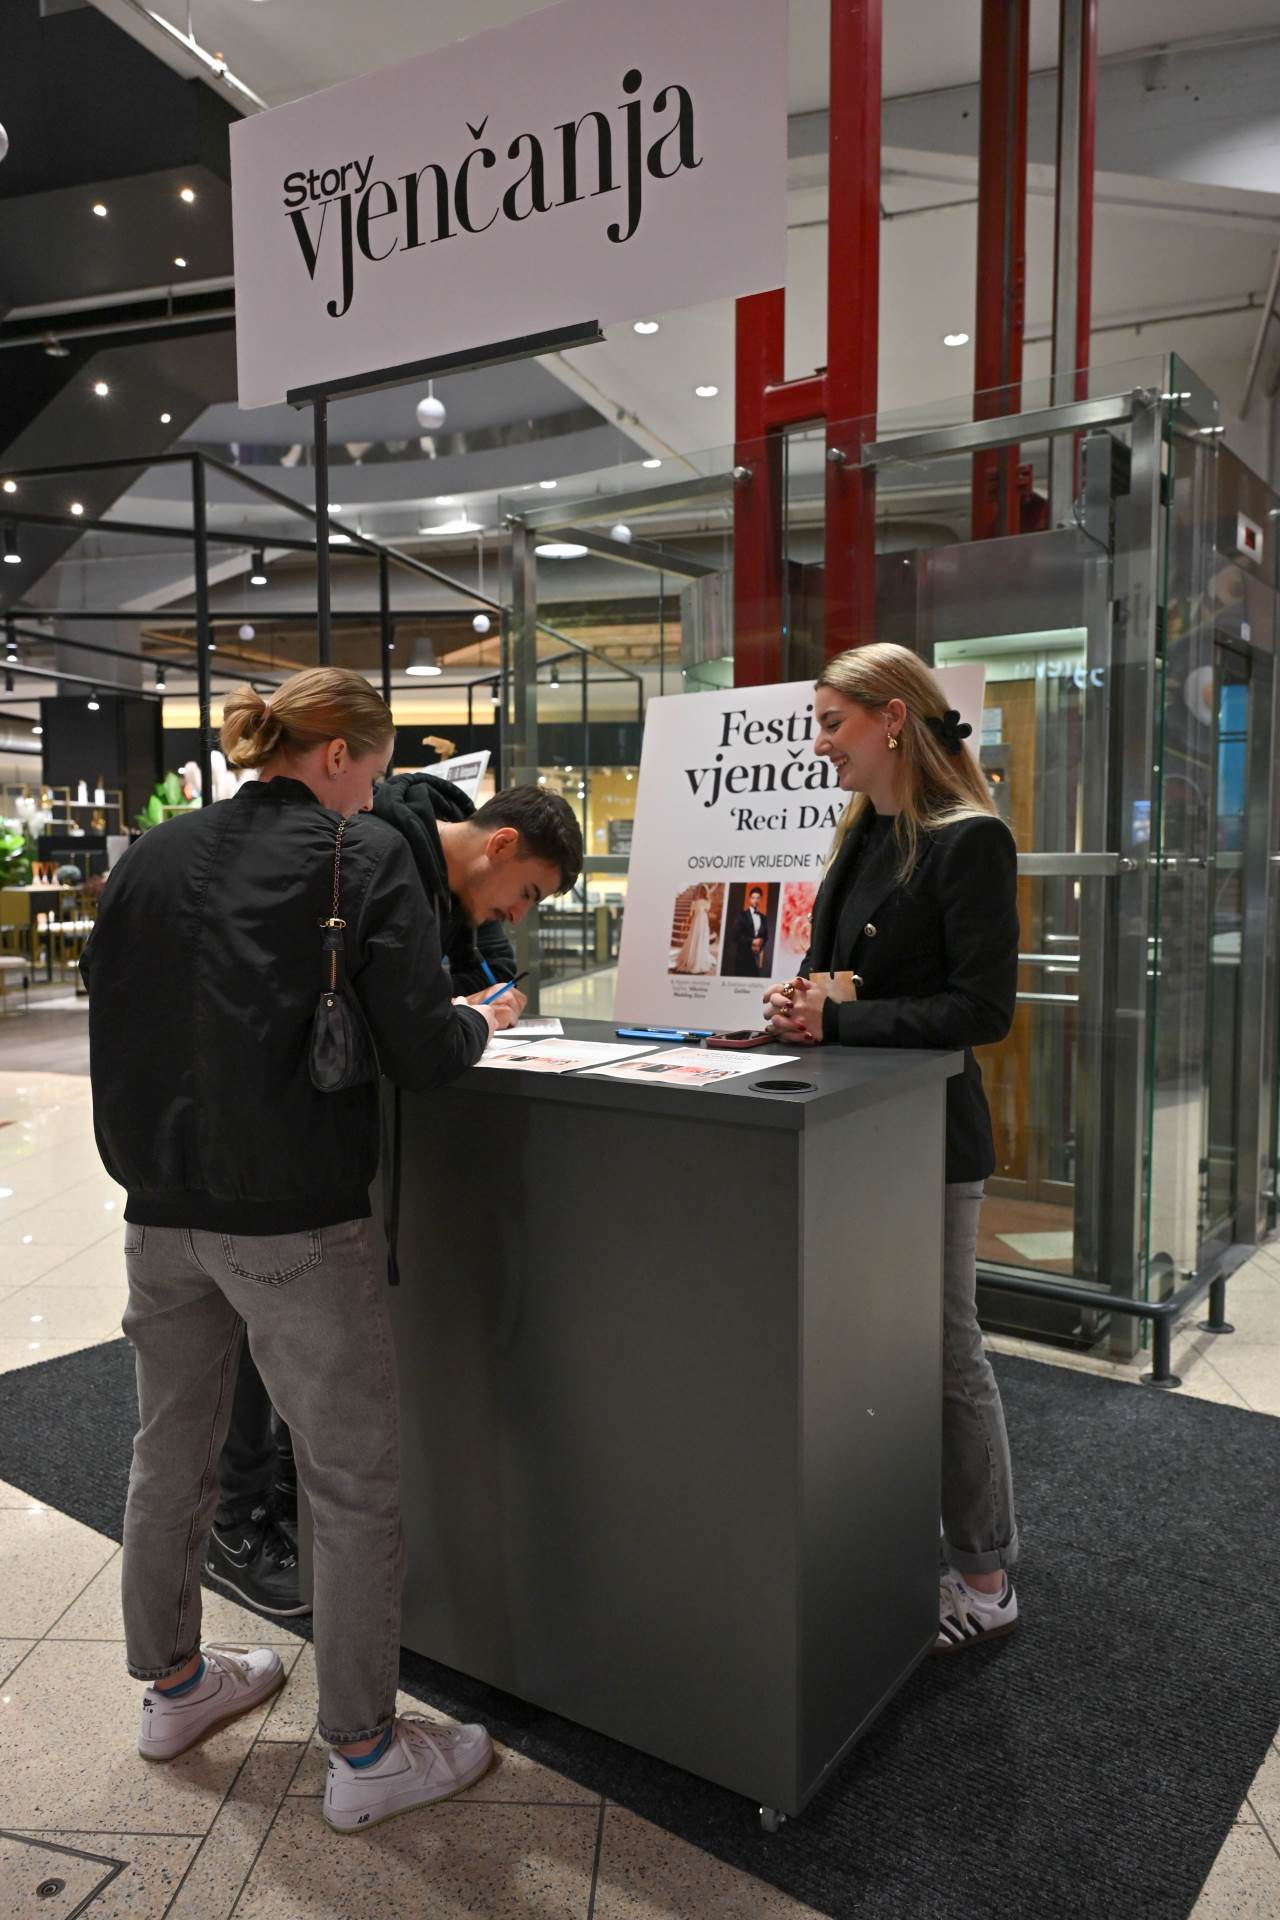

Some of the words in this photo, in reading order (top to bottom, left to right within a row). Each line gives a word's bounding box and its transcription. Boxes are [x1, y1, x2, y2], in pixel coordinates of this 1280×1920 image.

[283, 155, 374, 207] Story
[285, 69, 703, 318] vjenčanja
[687, 854, 746, 870] OSVOJITE
[750, 853, 811, 869] VRIJEDNE
